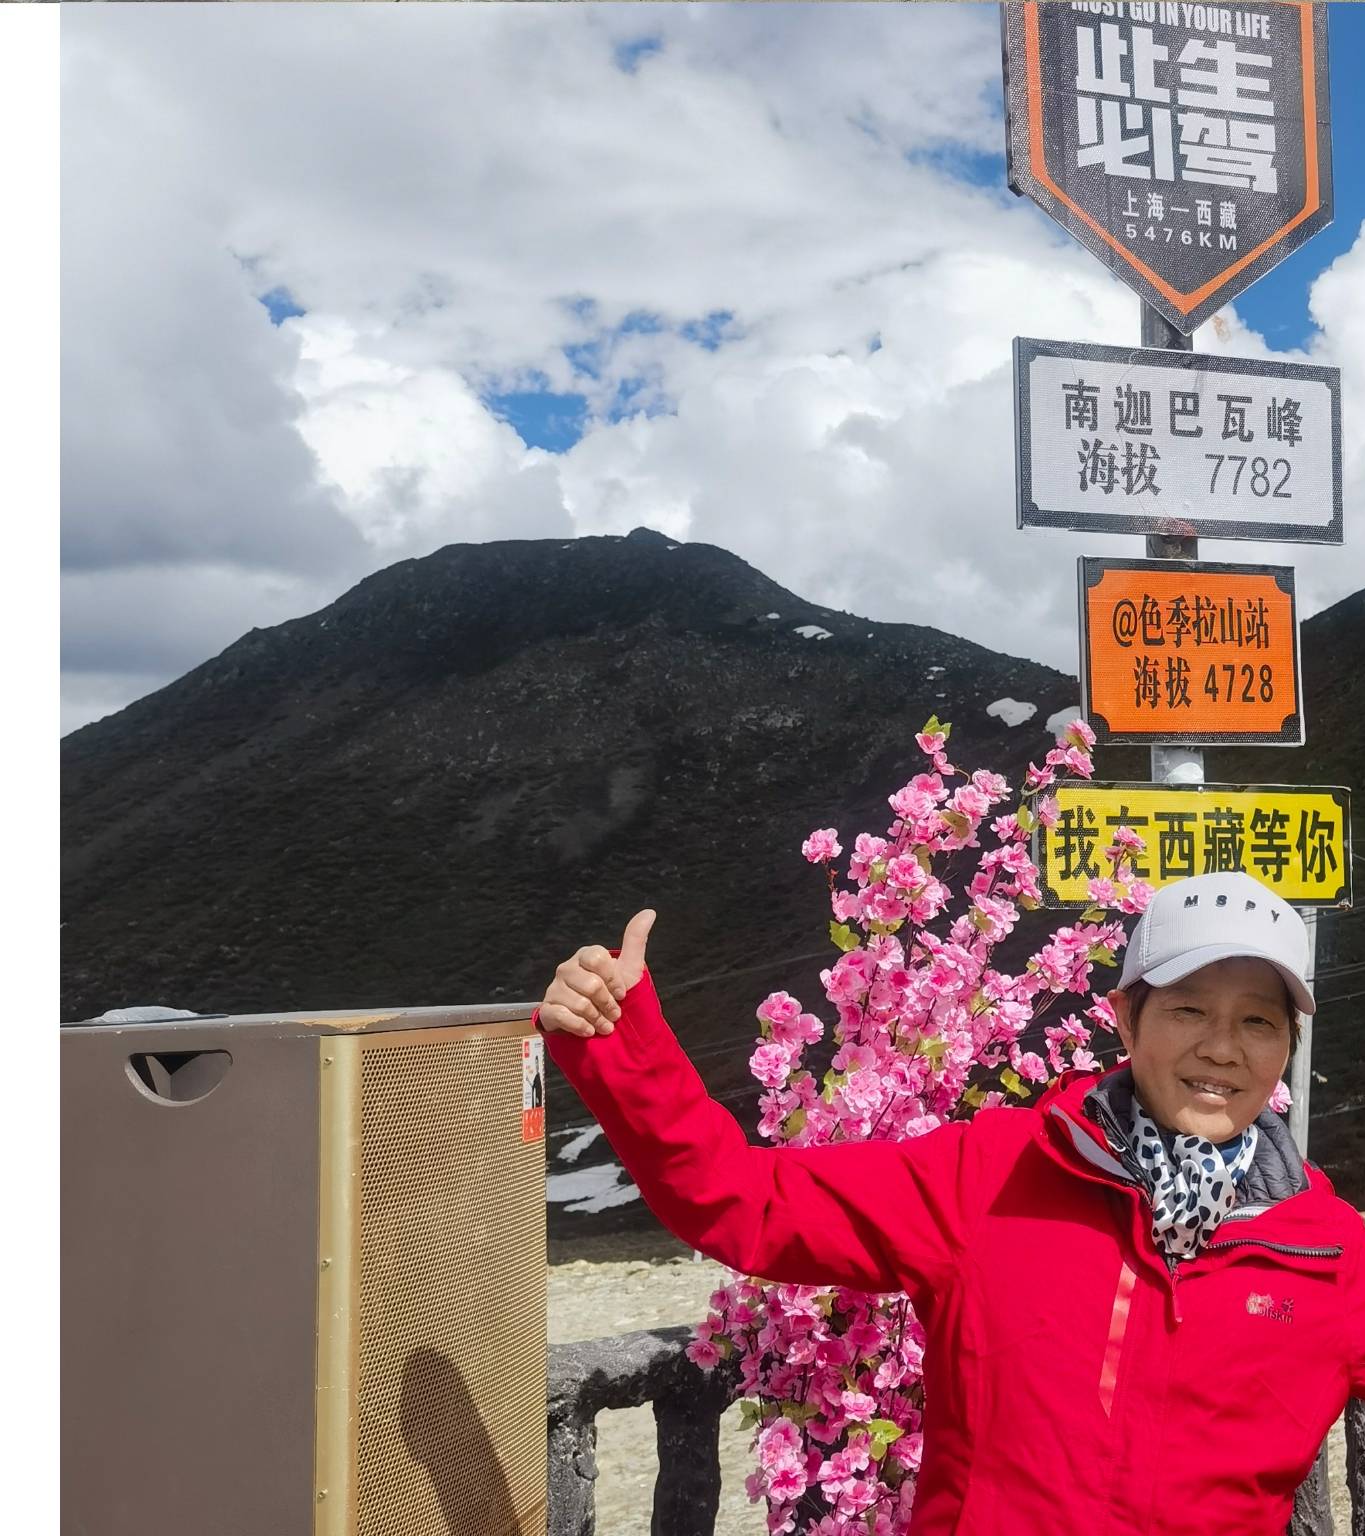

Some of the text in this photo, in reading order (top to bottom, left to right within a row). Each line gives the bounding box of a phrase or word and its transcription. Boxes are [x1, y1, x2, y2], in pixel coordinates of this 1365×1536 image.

[1159, 2, 1179, 27] IN
[1182, 3, 1233, 35] YOUR
[1234, 11, 1271, 40] LIFE
[1076, 22, 1275, 116] 此生
[1077, 96, 1278, 194] 必驾
[1126, 223, 1238, 251] 5476KM
[1061, 379, 1304, 447] 南迦巴瓦峰
[1077, 439, 1293, 499] 海拔 7782
[1112, 593, 1270, 650] @色季拉山站
[1133, 655, 1274, 710] 海拔 4728
[1184, 894, 1281, 922] MSPY
